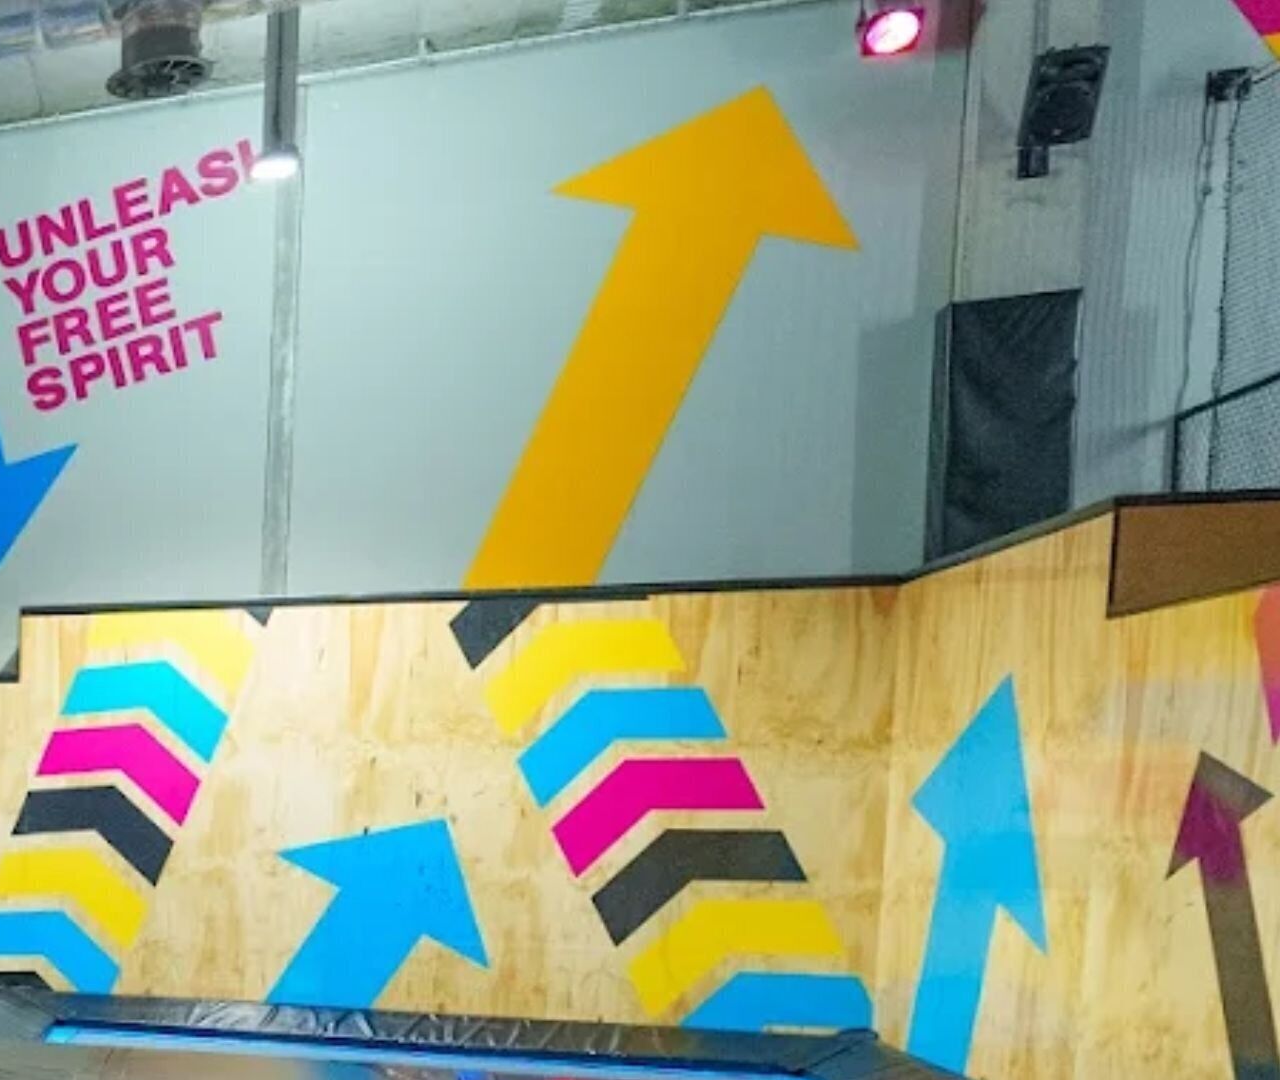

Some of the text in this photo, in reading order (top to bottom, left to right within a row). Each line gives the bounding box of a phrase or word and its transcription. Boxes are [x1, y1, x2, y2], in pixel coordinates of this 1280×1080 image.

[3, 225, 176, 316] YOUR
[16, 277, 178, 367] FREE
[25, 310, 224, 413] SPIRIT
